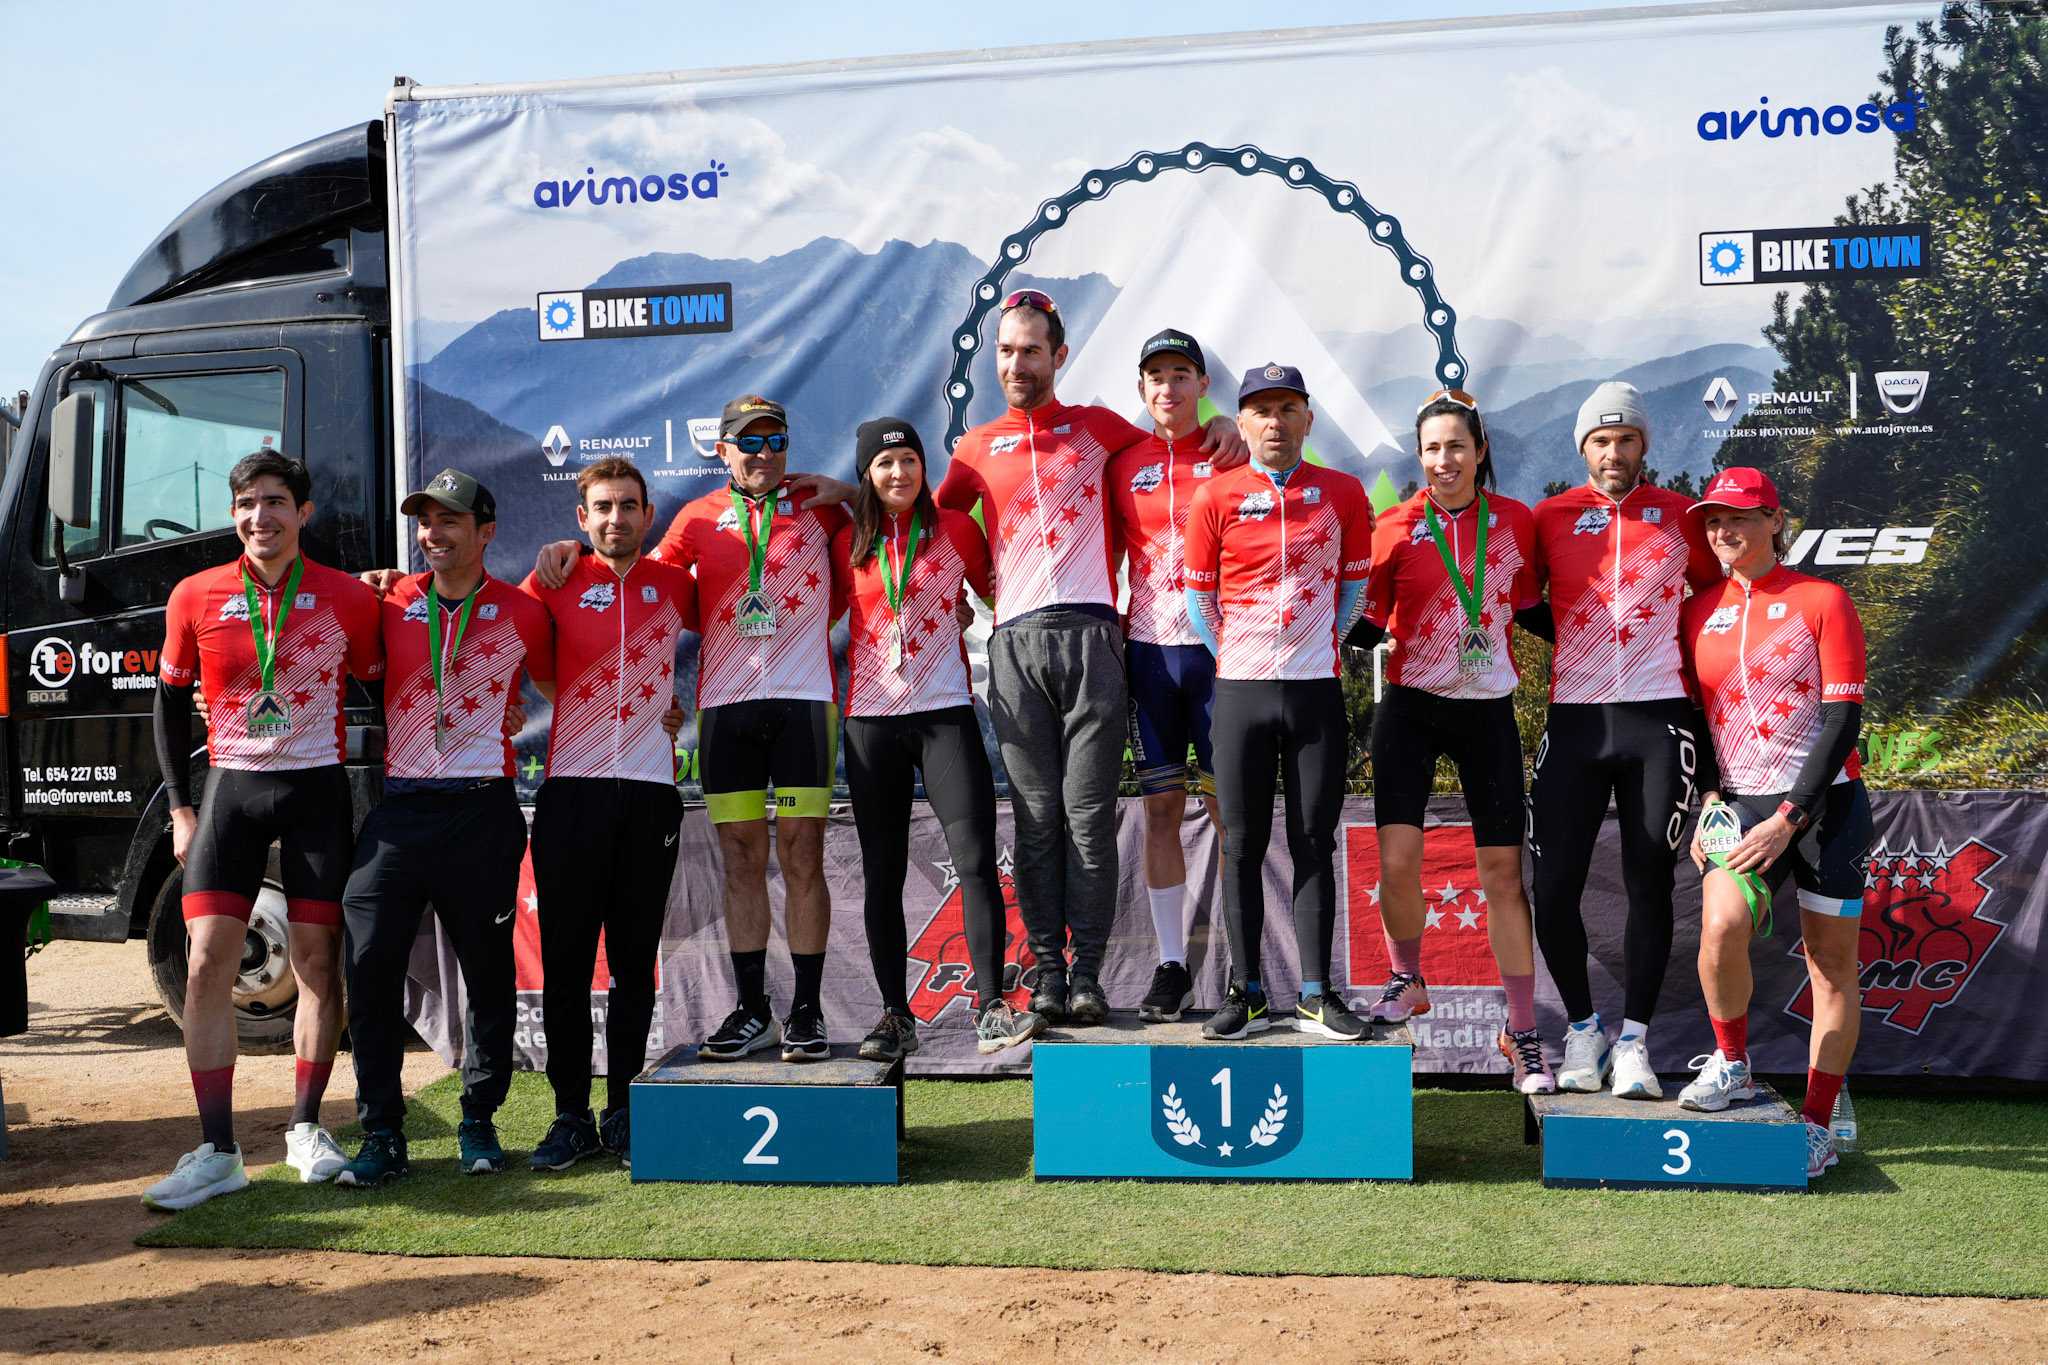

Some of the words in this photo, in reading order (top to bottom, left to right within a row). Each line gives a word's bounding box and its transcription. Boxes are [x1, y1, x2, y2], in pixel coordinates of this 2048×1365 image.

[1697, 96, 1917, 141] avimosa
[534, 166, 719, 208] avimosa
[1761, 235, 1921, 273] BIKETOWN
[589, 294, 725, 329] BIKETOWN
[1884, 378, 1920, 386] DACIA
[1748, 391, 1833, 404] RENAULT
[1748, 408, 1783, 417] Passion
[1784, 407, 1797, 415] for
[1798, 406, 1812, 415] life
[1702, 428, 1757, 439] TALLERES
[1759, 426, 1816, 438] HONTORIA
[1834, 423, 1934, 437] www.autojoven.es
[580, 436, 653, 450] RENAULT
[653, 466, 732, 477] www.autojoven.e
[739, 621, 776, 631] GREEN
[80, 642, 159, 674] forev
[1460, 659, 1493, 668] GREEN
[112, 674, 157, 690] servicios
[249, 723, 291, 733] GREEN
[23, 767, 44, 782] Tel.
[46, 767, 69, 781] 654
[71, 767, 92, 781] 227
[94, 766, 117, 780] 639
[24, 788, 132, 805] info@forevent.es
[1702, 837, 1741, 847] GREEN
[1211, 1067, 1232, 1128] 1
[743, 1106, 779, 1165] 2
[1662, 1129, 1692, 1176] 3
